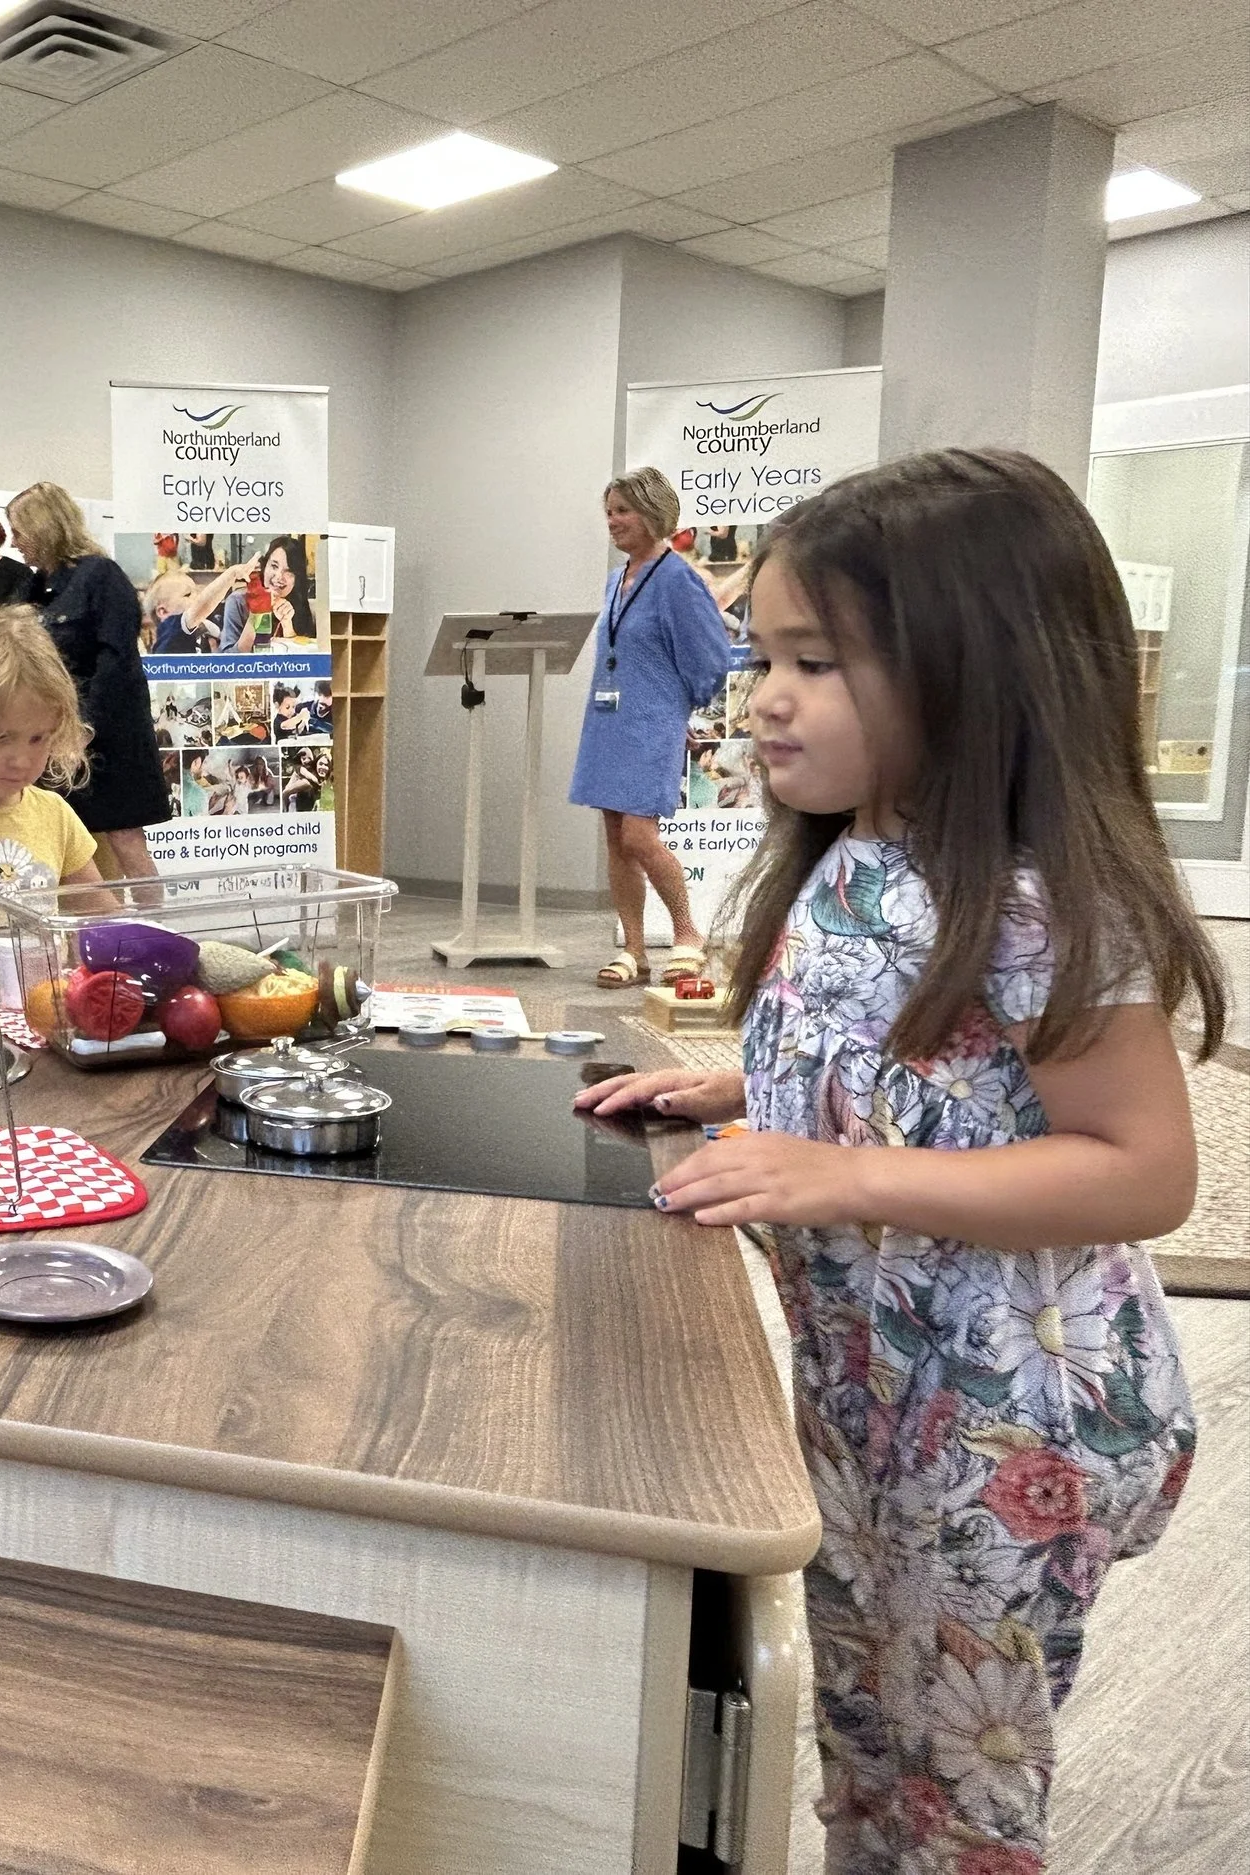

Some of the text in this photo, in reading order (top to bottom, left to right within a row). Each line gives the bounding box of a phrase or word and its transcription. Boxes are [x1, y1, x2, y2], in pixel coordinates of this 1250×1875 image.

[163, 430, 280, 446] Northumberland
[683, 417, 820, 440] Northumberland
[175, 446, 240, 466] county
[697, 436, 772, 456] county
[163, 475, 284, 501] Early Years
[681, 465, 821, 493] Early Years
[177, 501, 271, 522] Services
[145, 822, 321, 845] upports for licensed child
[711, 819, 731, 832] for
[180, 846, 190, 859] &
[194, 844, 250, 860] EarlyON
[254, 842, 318, 858] programs
[683, 838, 694, 850] &
